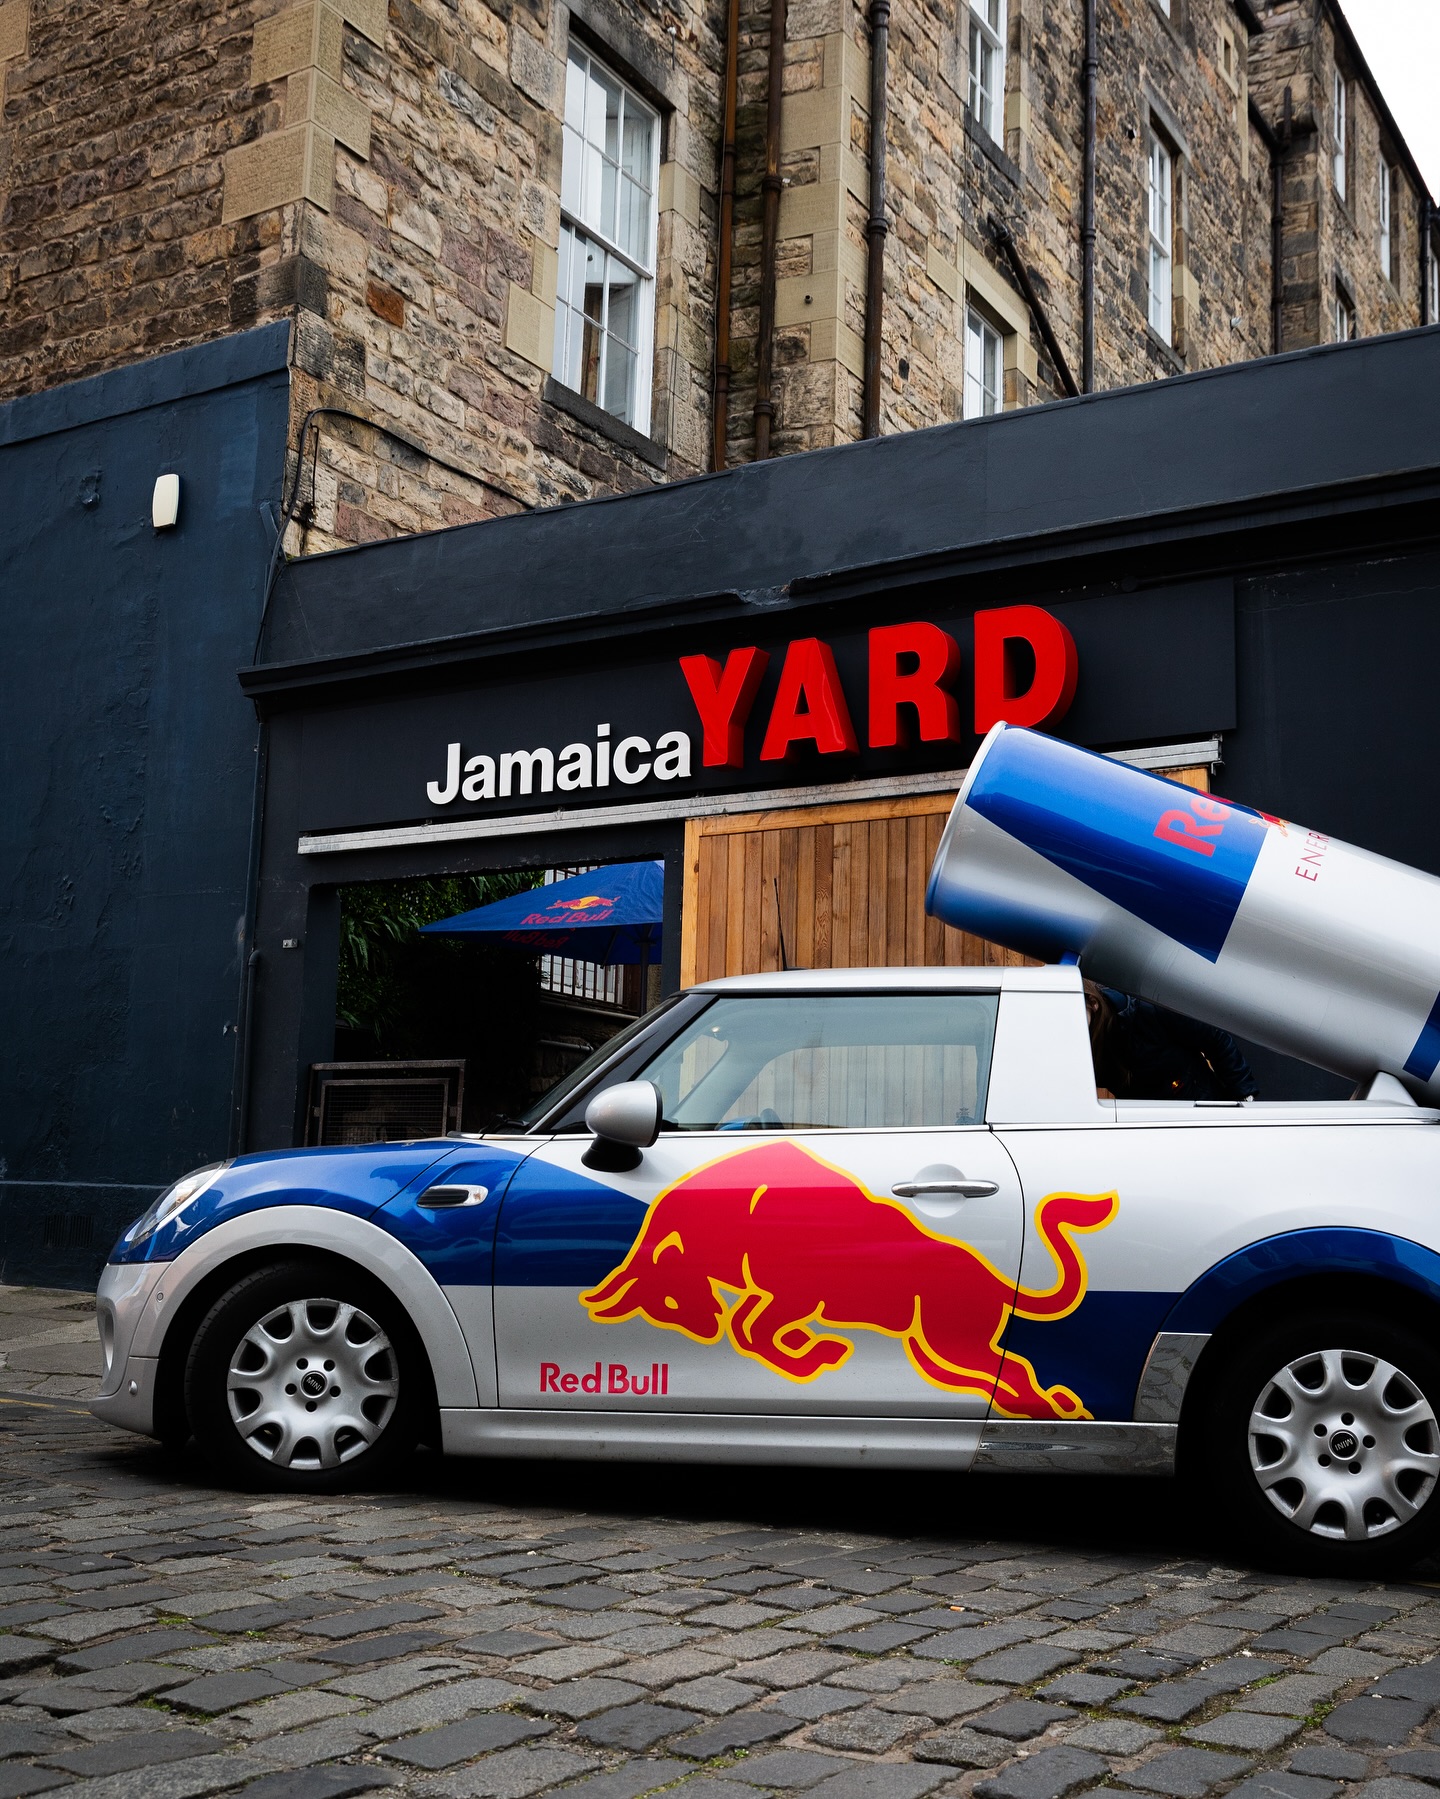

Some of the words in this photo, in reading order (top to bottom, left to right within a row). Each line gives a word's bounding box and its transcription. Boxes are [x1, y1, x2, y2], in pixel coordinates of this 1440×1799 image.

[426, 723, 692, 806] Jamaica
[678, 604, 1079, 770] YARD
[1152, 789, 1234, 857] Re
[520, 912, 570, 925] Red
[565, 910, 614, 923] Bull
[306, 1376, 322, 1391] MINI
[539, 1361, 602, 1394] Red
[607, 1363, 669, 1396] Bull
[1334, 1438, 1353, 1451] MINI
